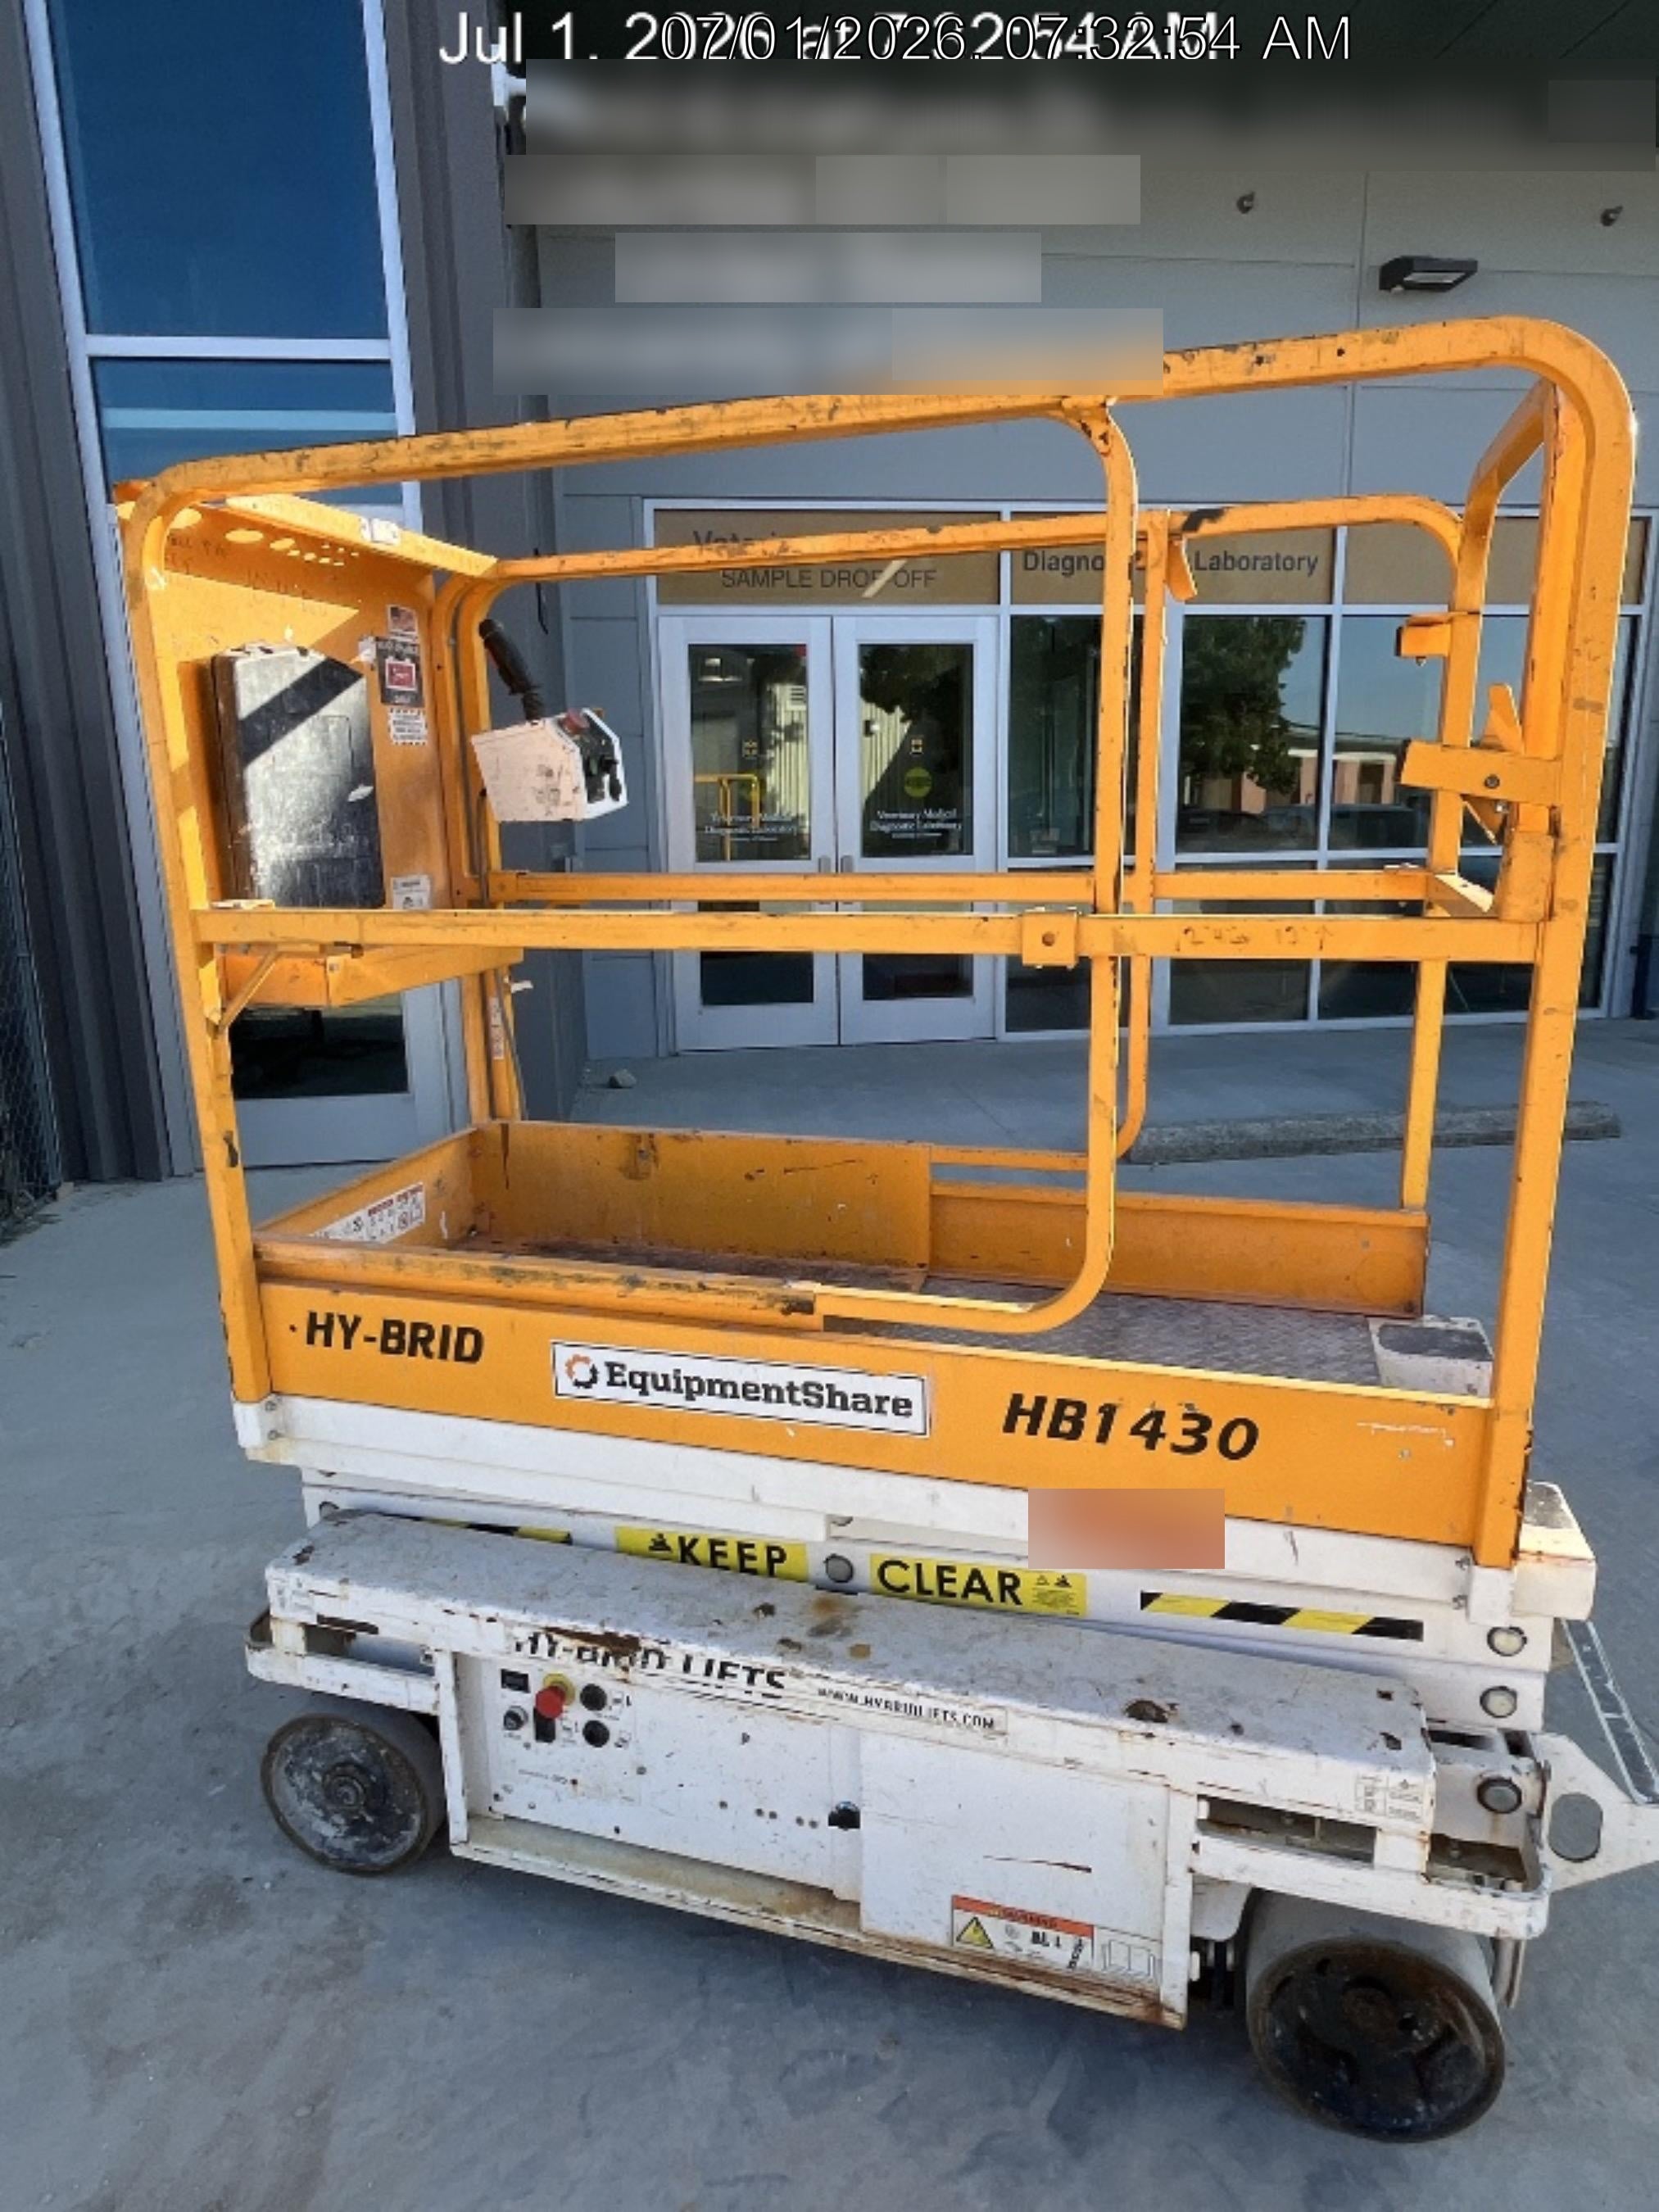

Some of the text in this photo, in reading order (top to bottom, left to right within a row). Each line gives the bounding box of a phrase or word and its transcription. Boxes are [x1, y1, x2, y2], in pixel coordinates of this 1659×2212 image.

[721, 569, 813, 589] SAMPLE
[1194, 550, 1319, 577] Laboratory
[306, 1310, 484, 1365] HY-BRID
[604, 1361, 913, 1419] EquipmentShare
[1002, 1392, 1260, 1462] HB1430
[677, 1534, 788, 1579] KEEP
[877, 1559, 1023, 1606] CLEAR
